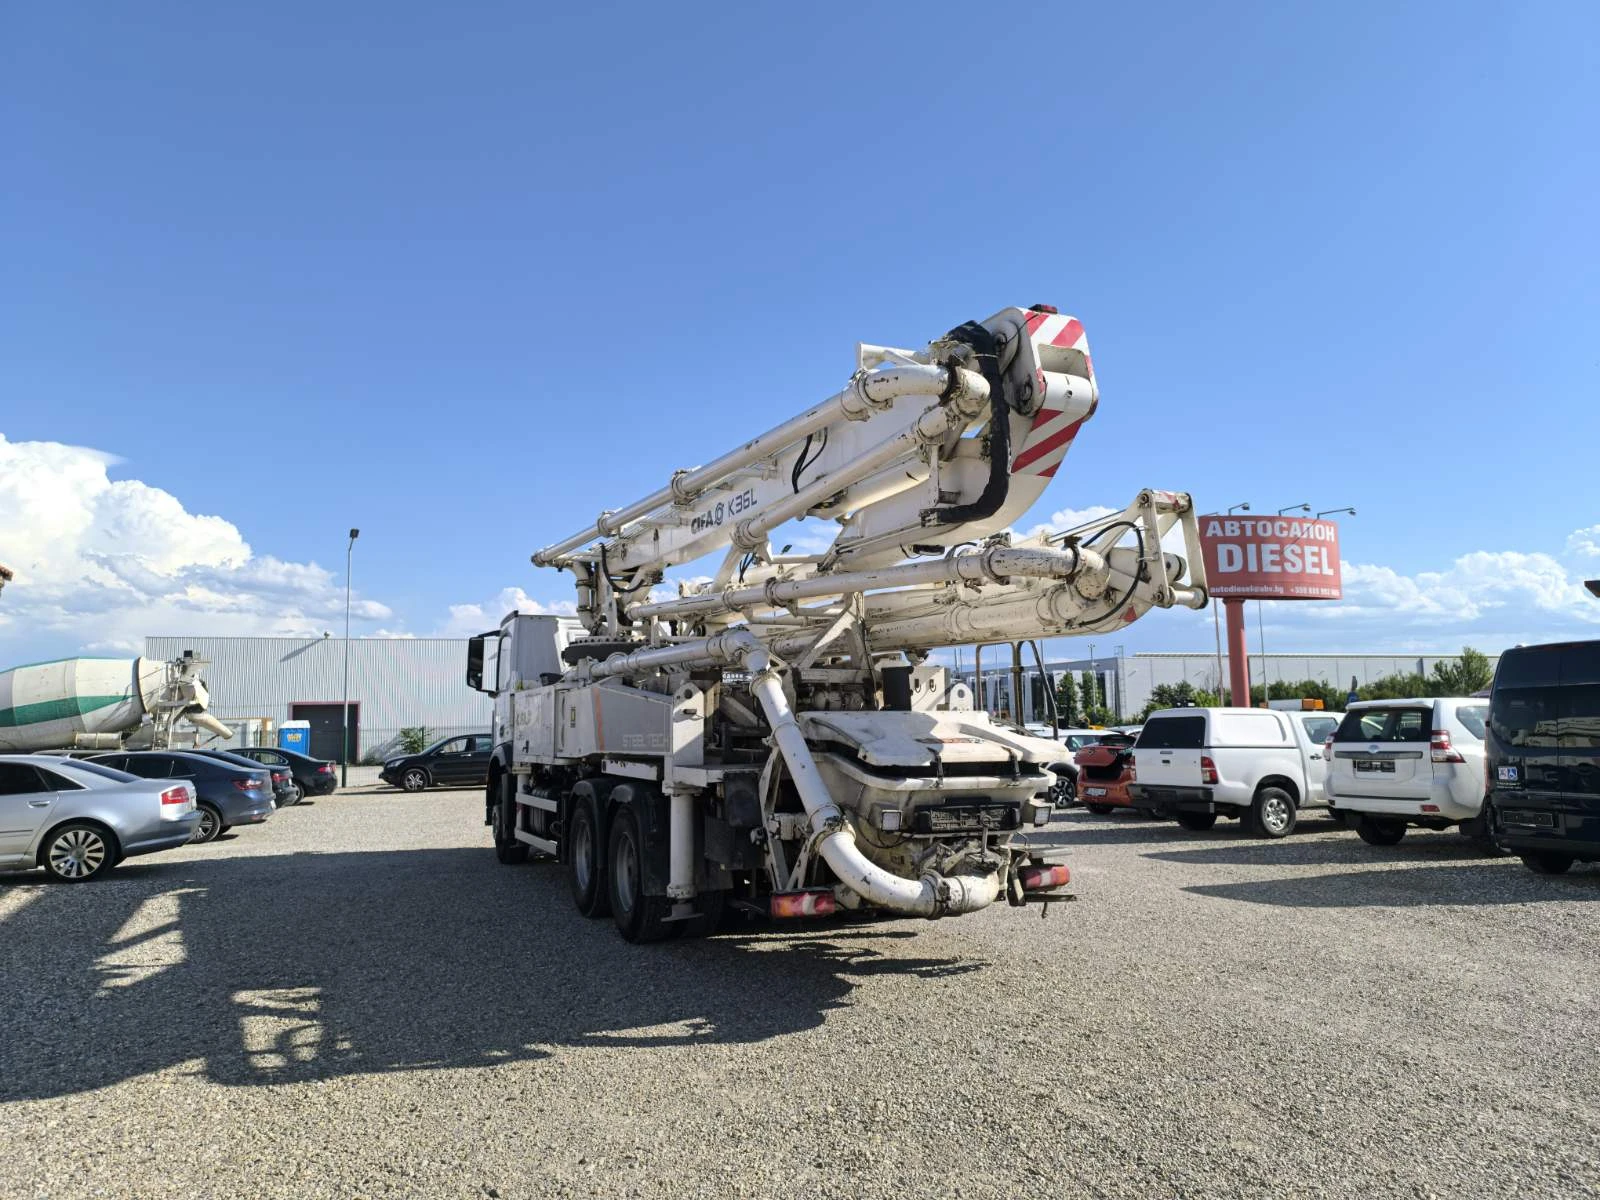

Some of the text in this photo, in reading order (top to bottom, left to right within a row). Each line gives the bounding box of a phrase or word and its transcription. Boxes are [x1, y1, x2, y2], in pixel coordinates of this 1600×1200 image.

[727, 488, 757, 518] K36L
[1206, 520, 1335, 542] АВТОСАЛОН
[1217, 543, 1334, 576] DIESEL
